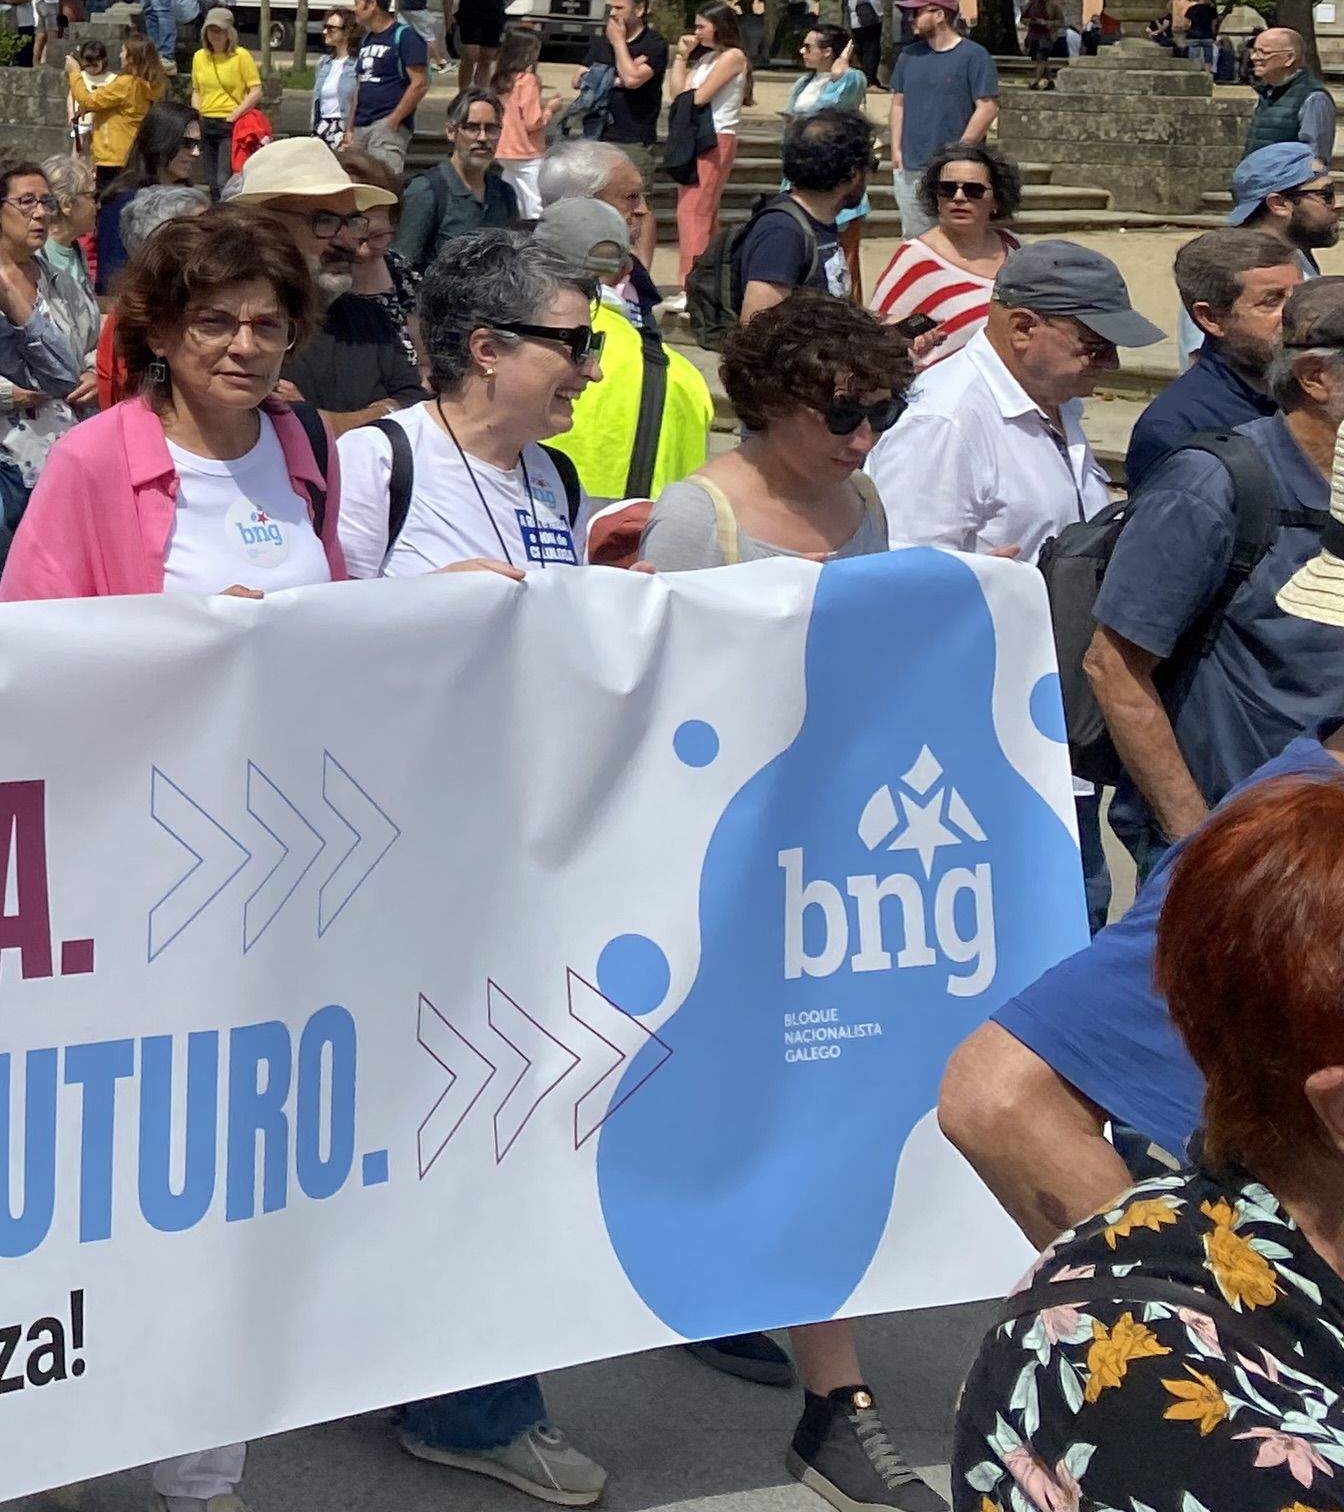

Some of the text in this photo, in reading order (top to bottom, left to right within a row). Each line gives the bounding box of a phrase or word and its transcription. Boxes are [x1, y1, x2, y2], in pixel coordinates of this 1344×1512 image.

[235, 522, 283, 546] bng
[778, 847, 995, 997] bng
[784, 1008, 838, 1028] BLOQUE
[784, 1022, 883, 1044] NACIONALISTA
[785, 1044, 841, 1063] GALEGO
